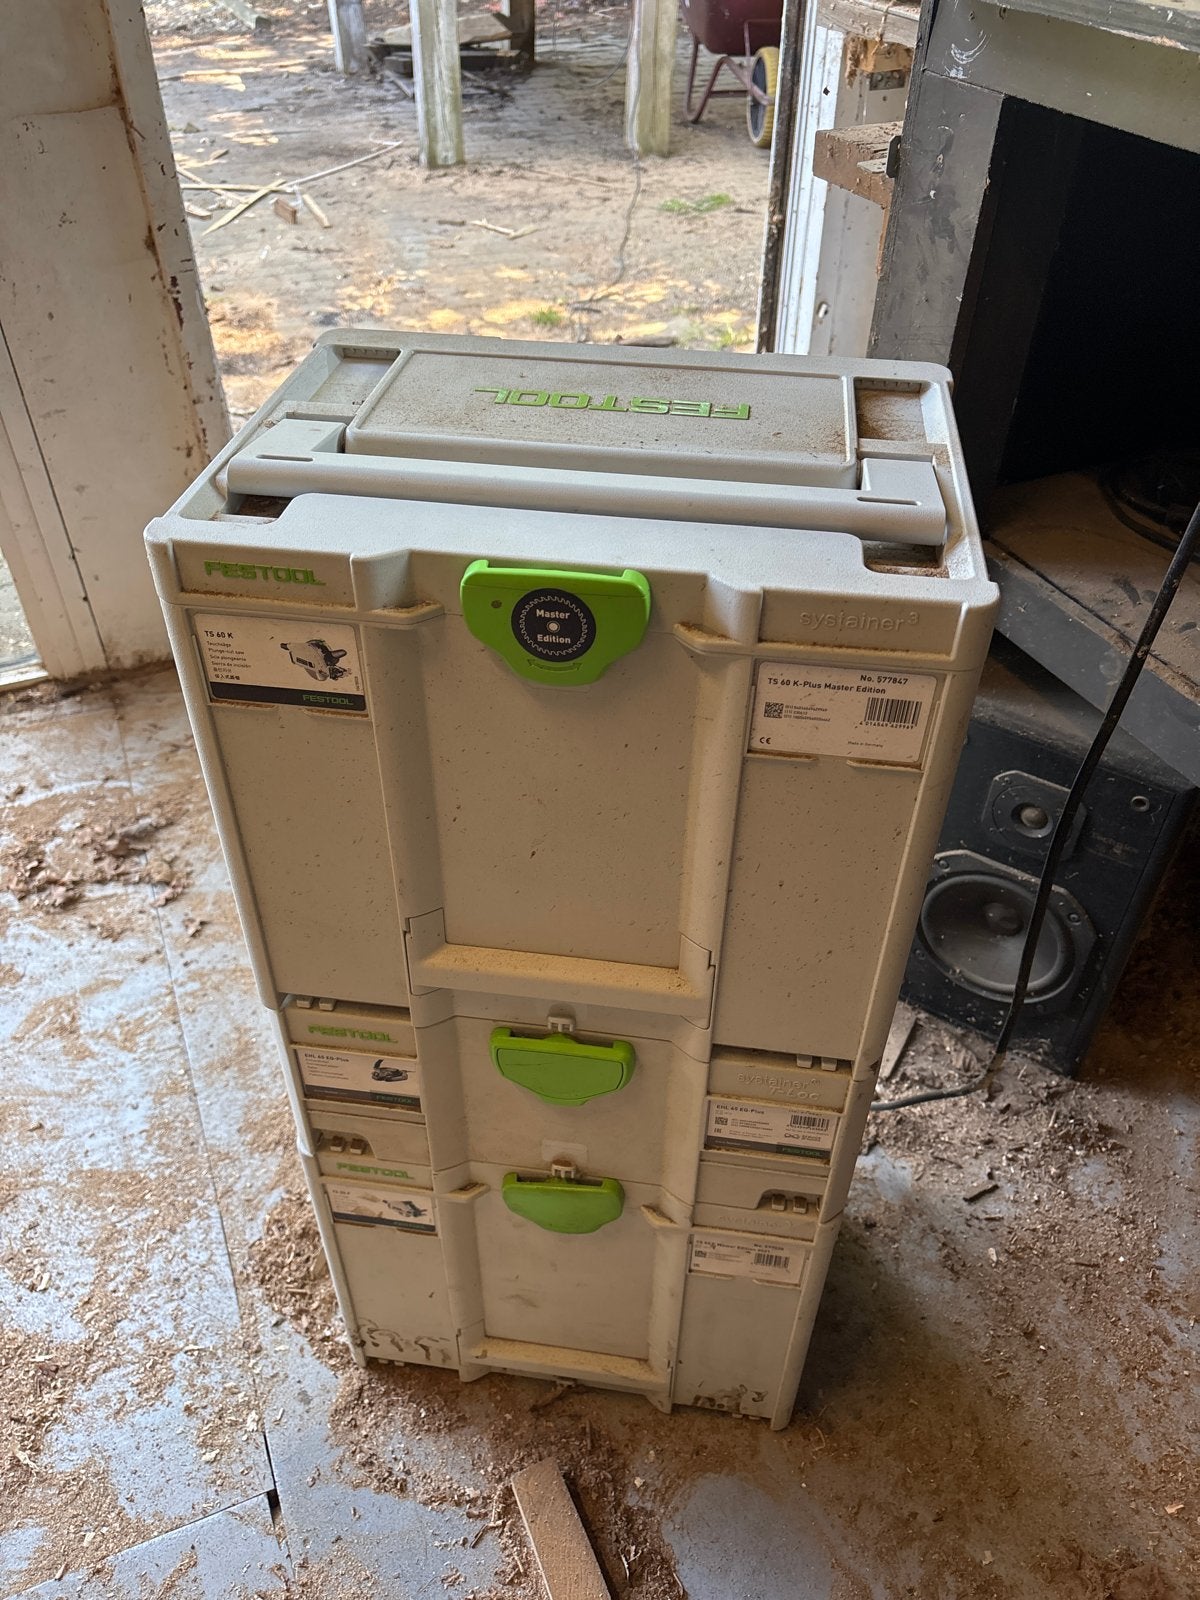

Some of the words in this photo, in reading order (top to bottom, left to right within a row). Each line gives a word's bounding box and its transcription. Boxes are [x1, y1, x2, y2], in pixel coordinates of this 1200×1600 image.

[474, 387, 750, 420] FESTOOL
[203, 560, 326, 586] FESTOOL
[535, 608, 571, 620] Master
[204, 630, 215, 638] TS
[216, 631, 226, 639] 60
[537, 634, 571, 645] Edition
[768, 677, 778, 685] TS
[793, 680, 822, 689] K-Plus
[824, 683, 854, 692] Master
[856, 685, 886, 694] Edition
[860, 674, 874, 683] No.
[877, 675, 908, 685] 577847
[302, 694, 355, 706] FESTOOL
[307, 1024, 399, 1044] FESTOOL
